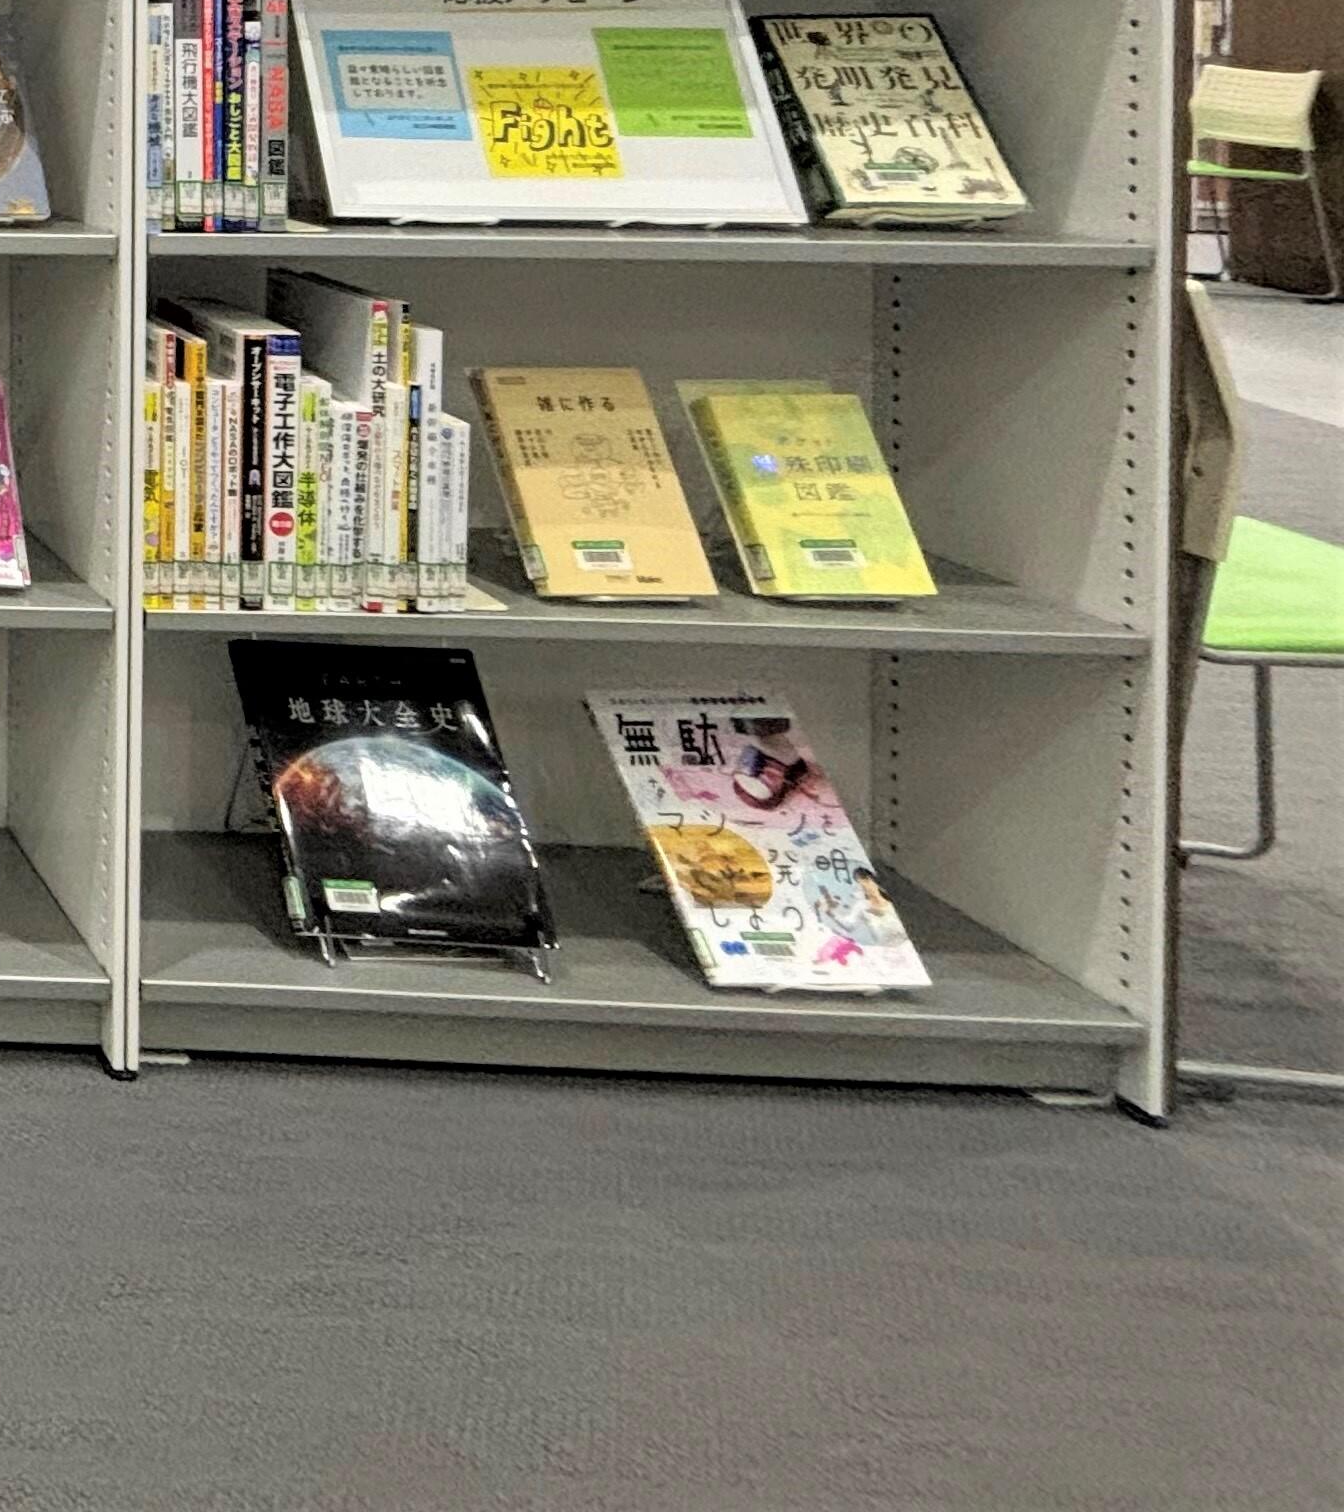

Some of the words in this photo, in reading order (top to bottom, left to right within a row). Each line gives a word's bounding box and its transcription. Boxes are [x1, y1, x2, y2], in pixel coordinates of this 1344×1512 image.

[182, 42, 198, 138] 飛行機大図鑑
[490, 99, 613, 151] Fight
[372, 351, 385, 418] 土の大研究
[272, 373, 296, 509] 電子工作大図鑑
[288, 697, 459, 732] 地球大全史
[615, 712, 726, 766] 無駄
[658, 811, 837, 836] マシーンを
[768, 848, 853, 885] 発明
